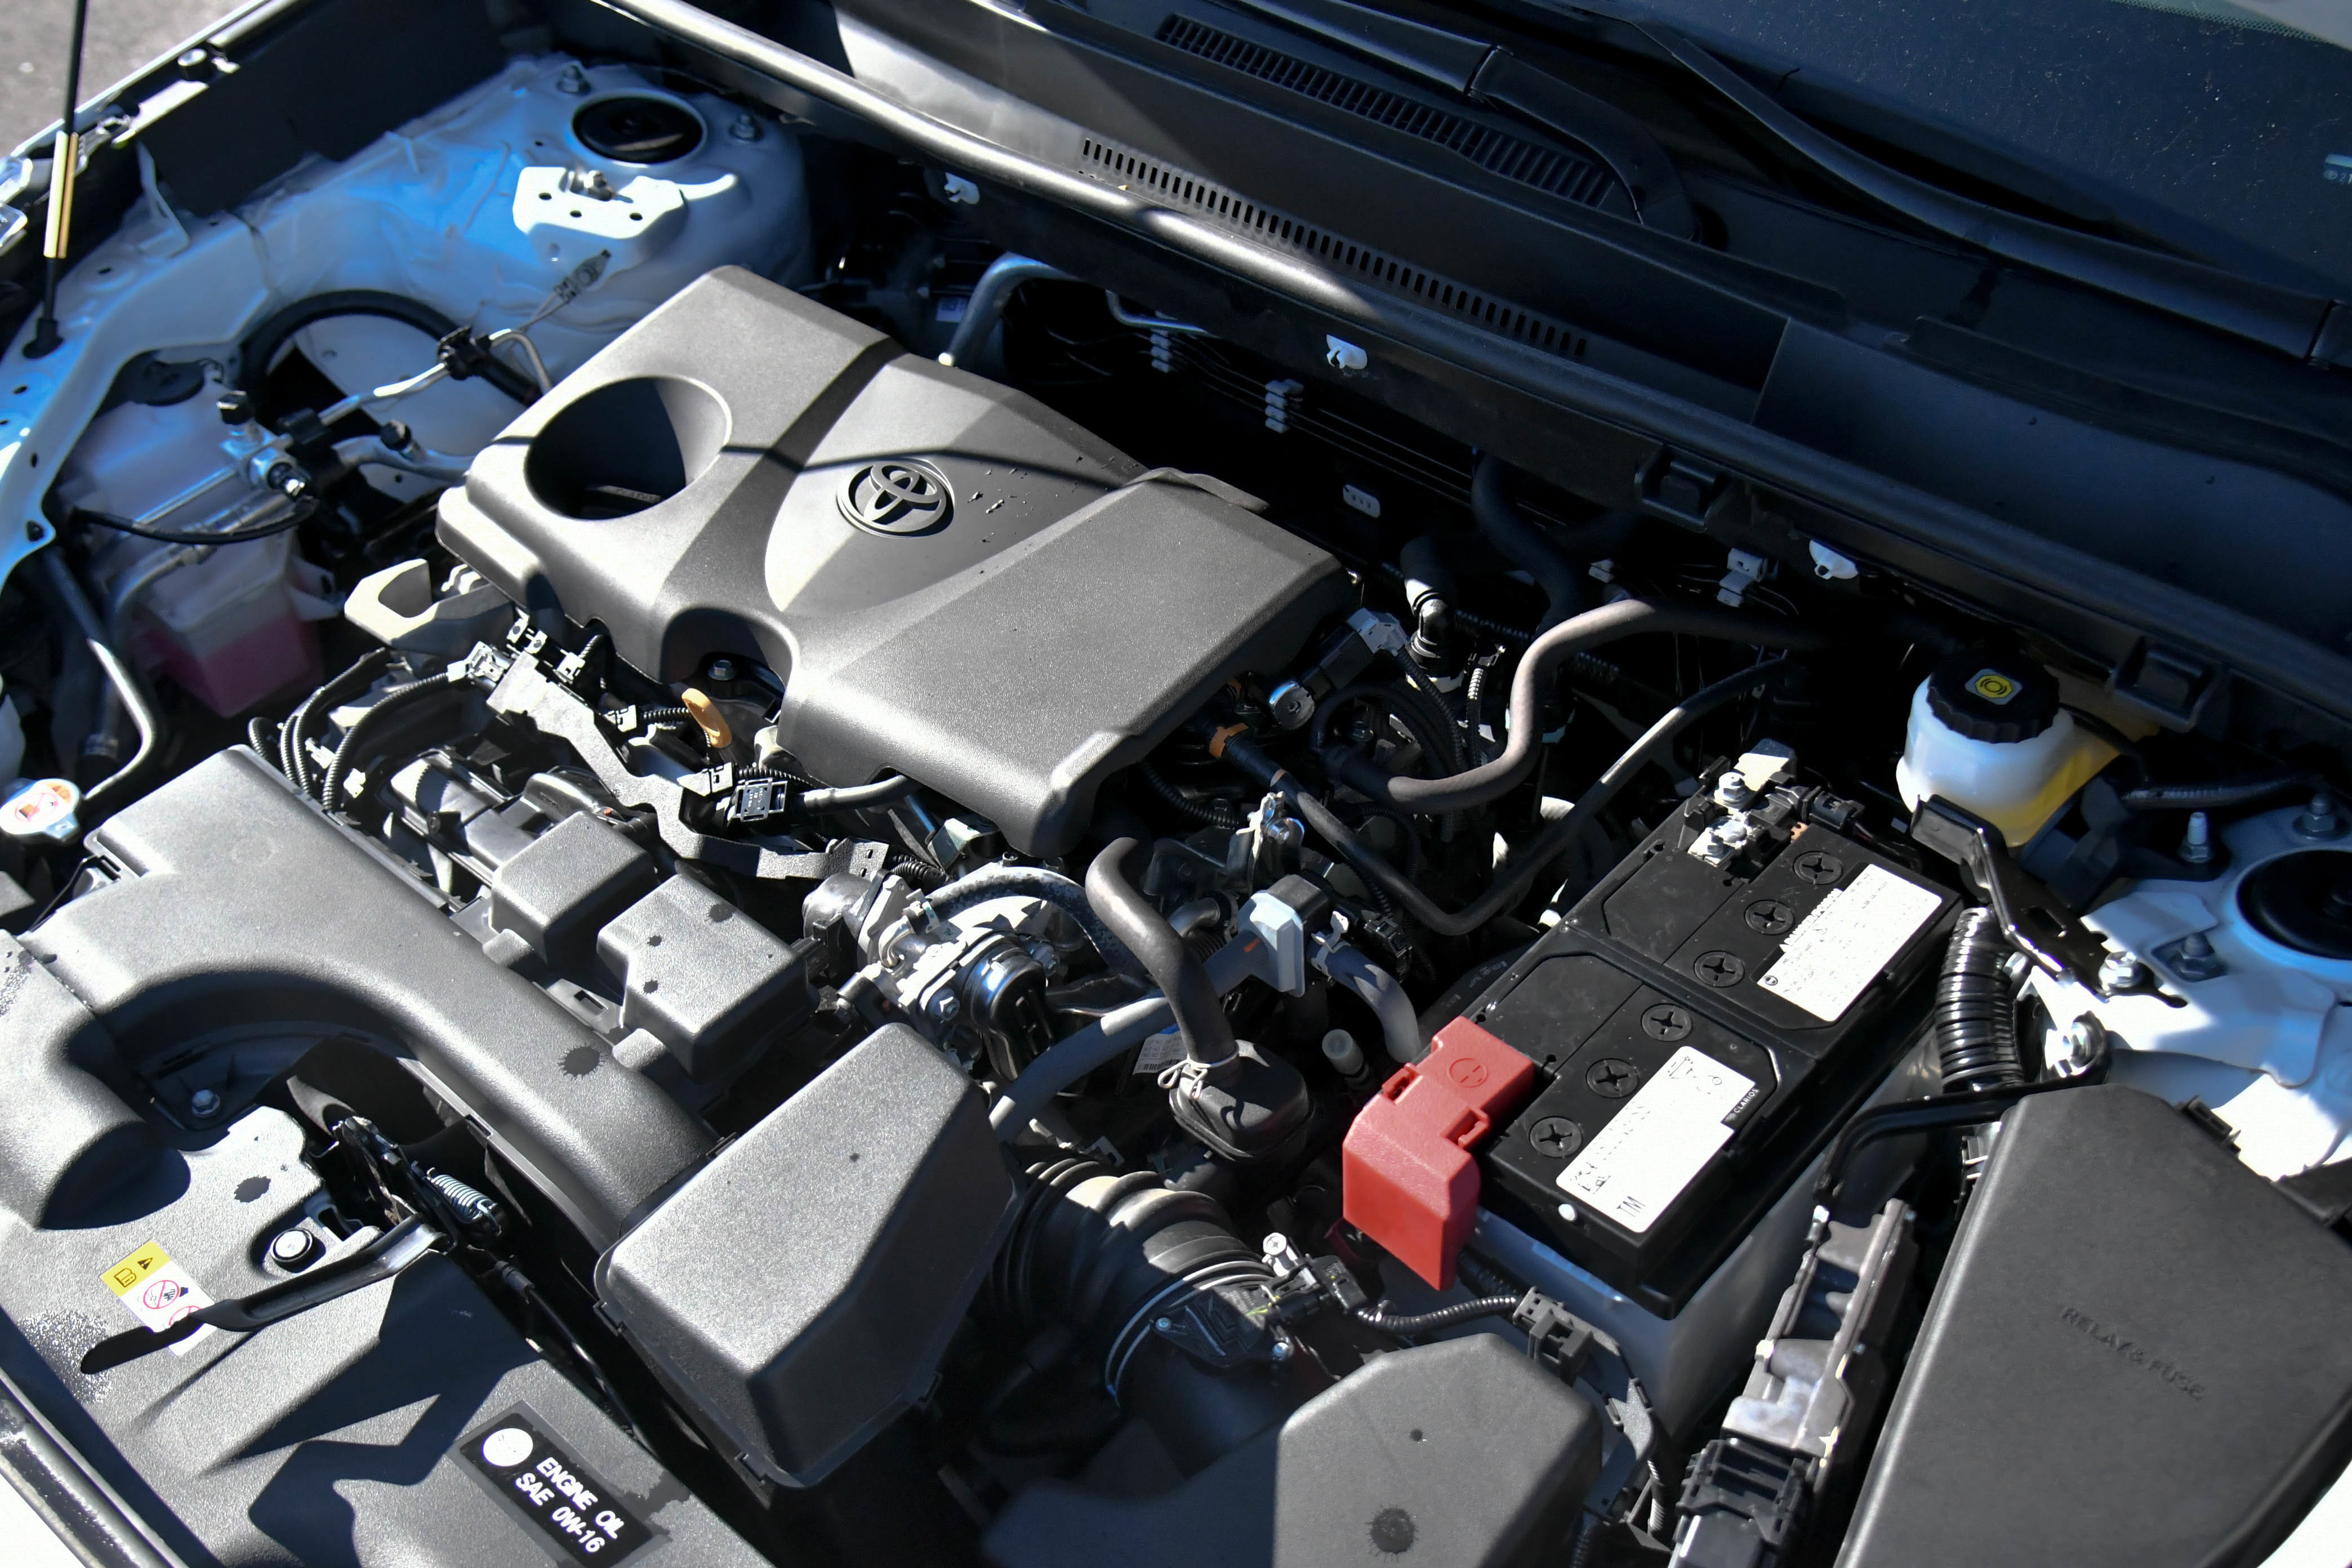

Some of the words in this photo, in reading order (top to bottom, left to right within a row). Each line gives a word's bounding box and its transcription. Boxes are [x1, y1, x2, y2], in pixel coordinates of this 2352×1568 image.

[1734, 1088, 1758, 1113] CLARIOS
[1616, 1195, 1646, 1218] TM
[515, 1473, 555, 1506] SAE
[551, 1507, 605, 1552] 0W-16
[536, 1457, 598, 1511] ENGINE
[595, 1510, 625, 1539] OIL
